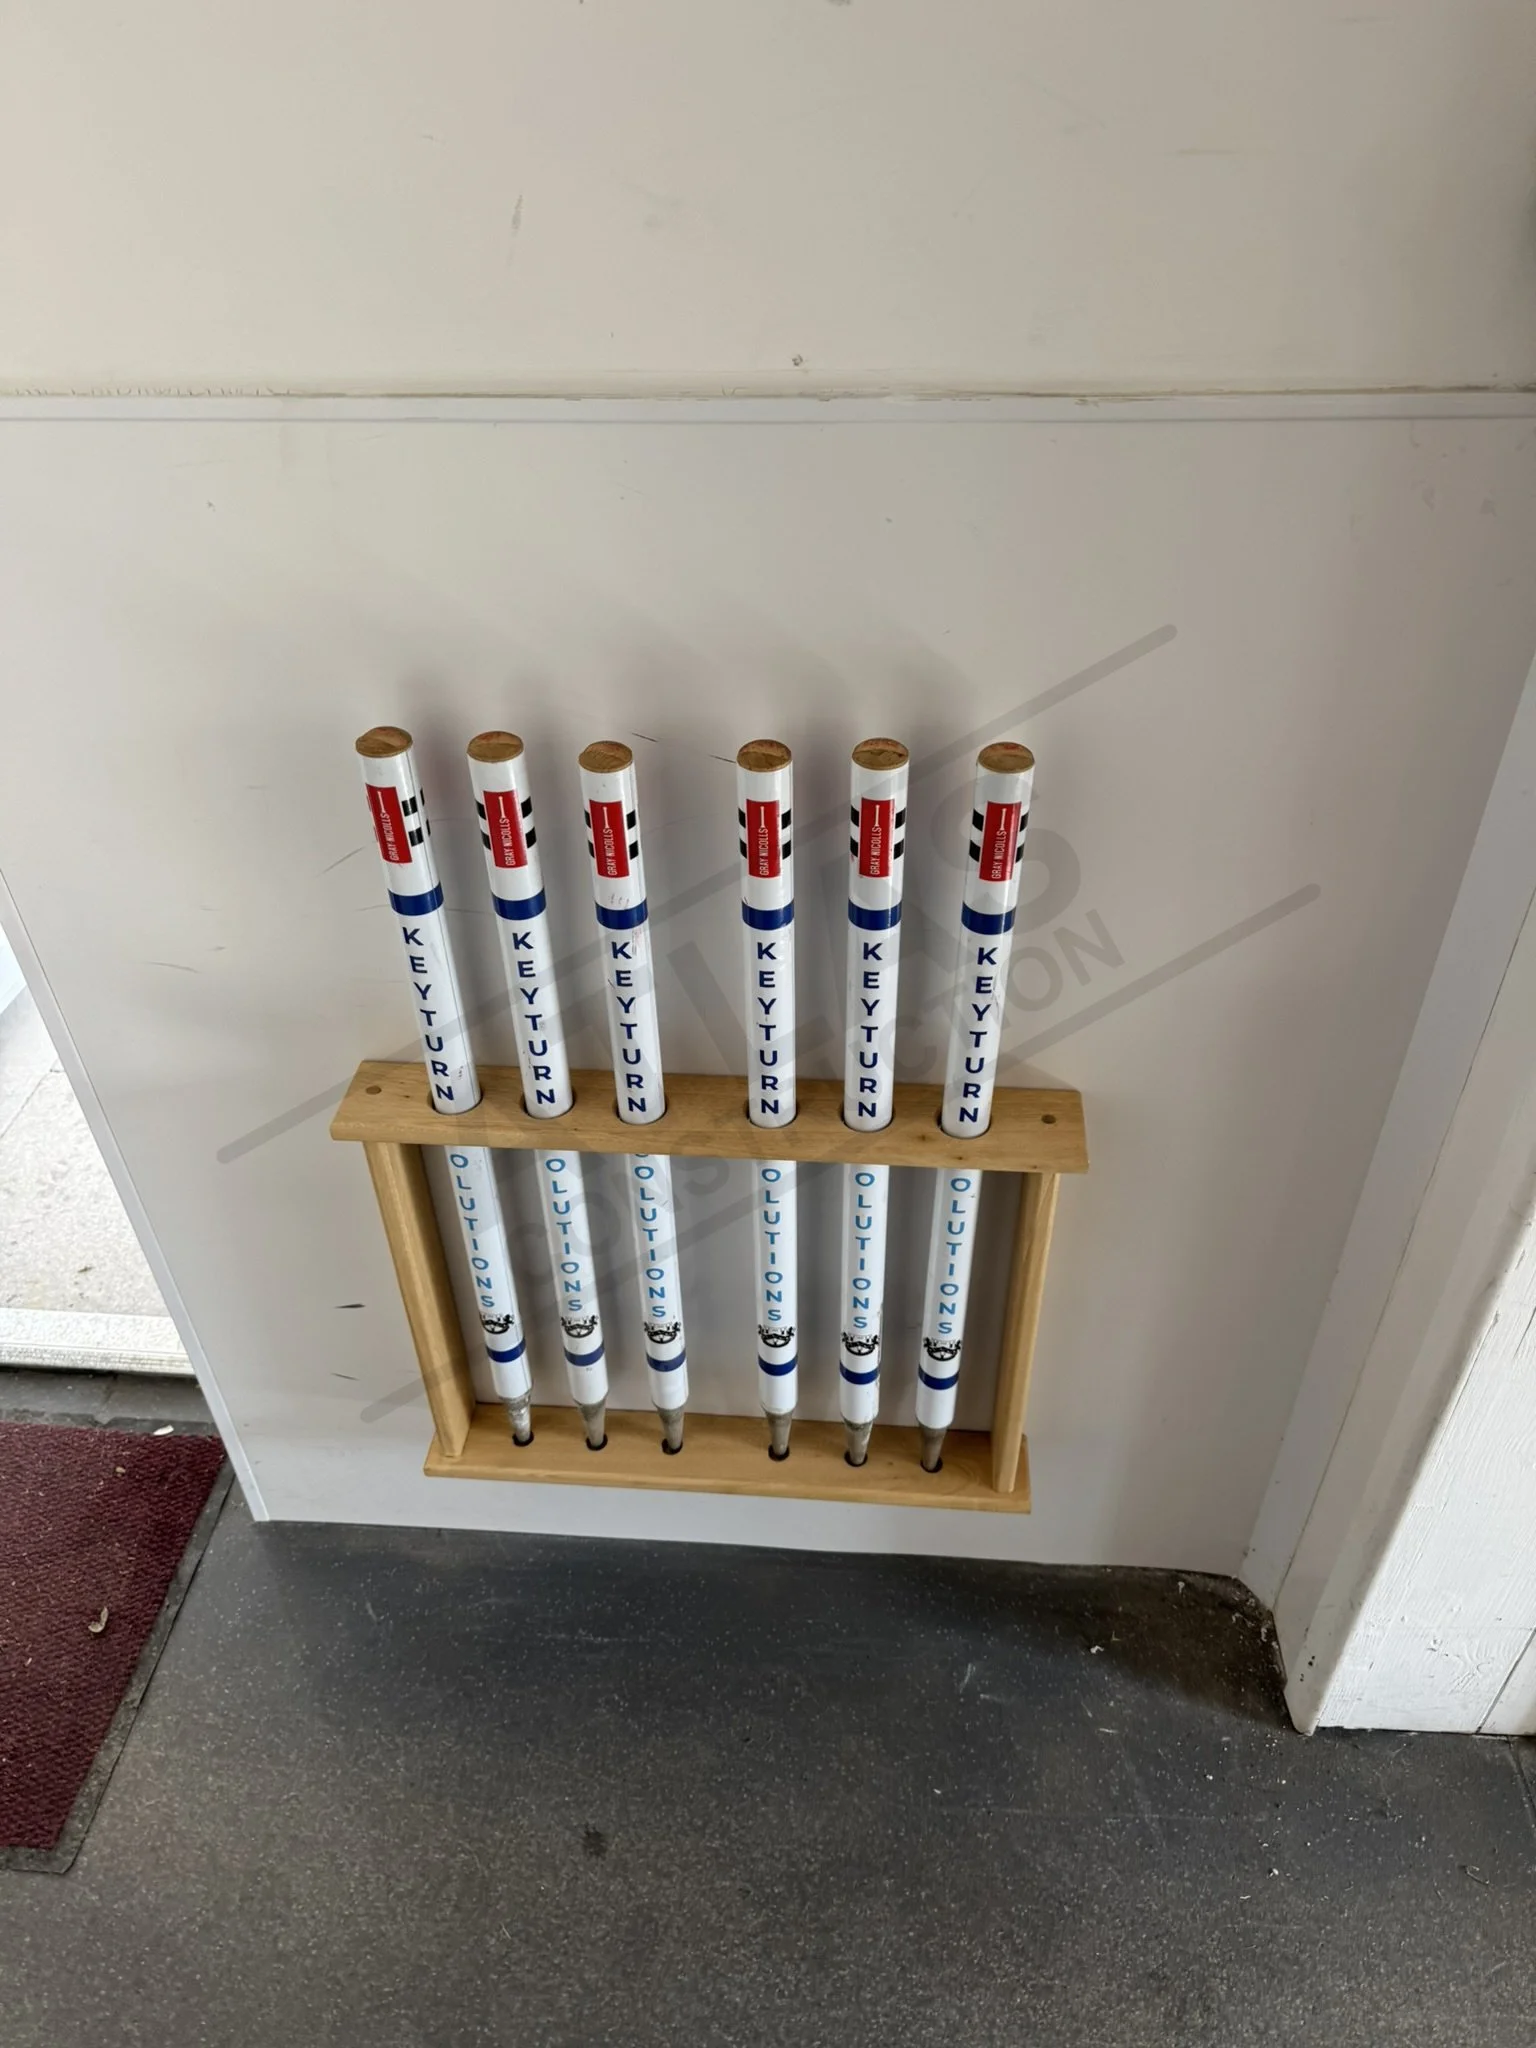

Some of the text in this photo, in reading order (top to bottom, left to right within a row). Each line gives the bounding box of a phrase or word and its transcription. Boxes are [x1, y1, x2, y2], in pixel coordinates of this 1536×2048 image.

[402, 926, 454, 1101] KEYTURN
[512, 931, 556, 1104] KEYTURN
[612, 941, 646, 1113] KEYTURN
[757, 942, 779, 1115] KEYTURN
[858, 942, 882, 1118] KEYTURN
[959, 947, 999, 1123] KEYTURN
[450, 1154, 495, 1308] OLUTIONS
[545, 1158, 583, 1312] OLUTIONS
[634, 1154, 667, 1318] OLUTIONS
[761, 1168, 783, 1322] OLUTIONS
[852, 1172, 876, 1329] OLUTIONS
[937, 1177, 972, 1335] OLUTIONS
